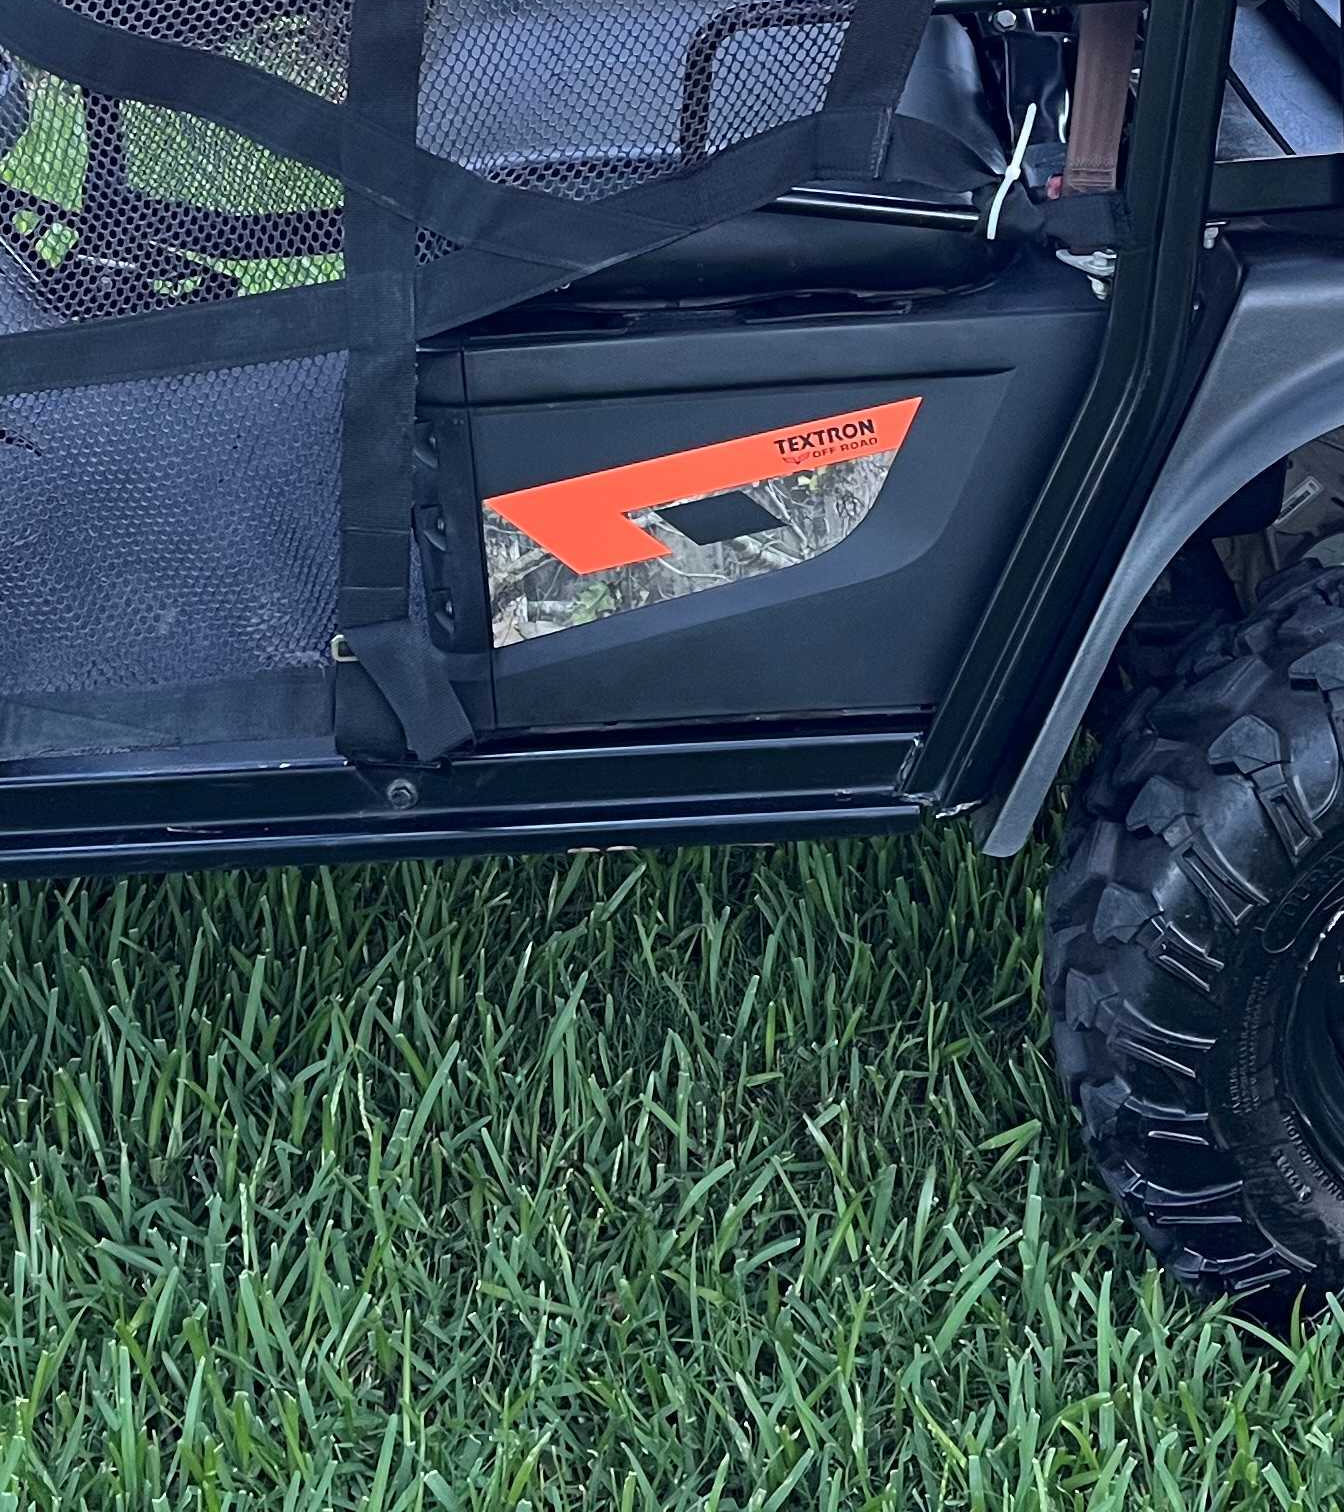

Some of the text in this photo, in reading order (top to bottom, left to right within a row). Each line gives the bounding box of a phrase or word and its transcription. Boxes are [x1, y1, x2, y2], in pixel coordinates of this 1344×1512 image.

[773, 419, 875, 455] TEXTRON
[812, 437, 878, 458] OFF ROAD
